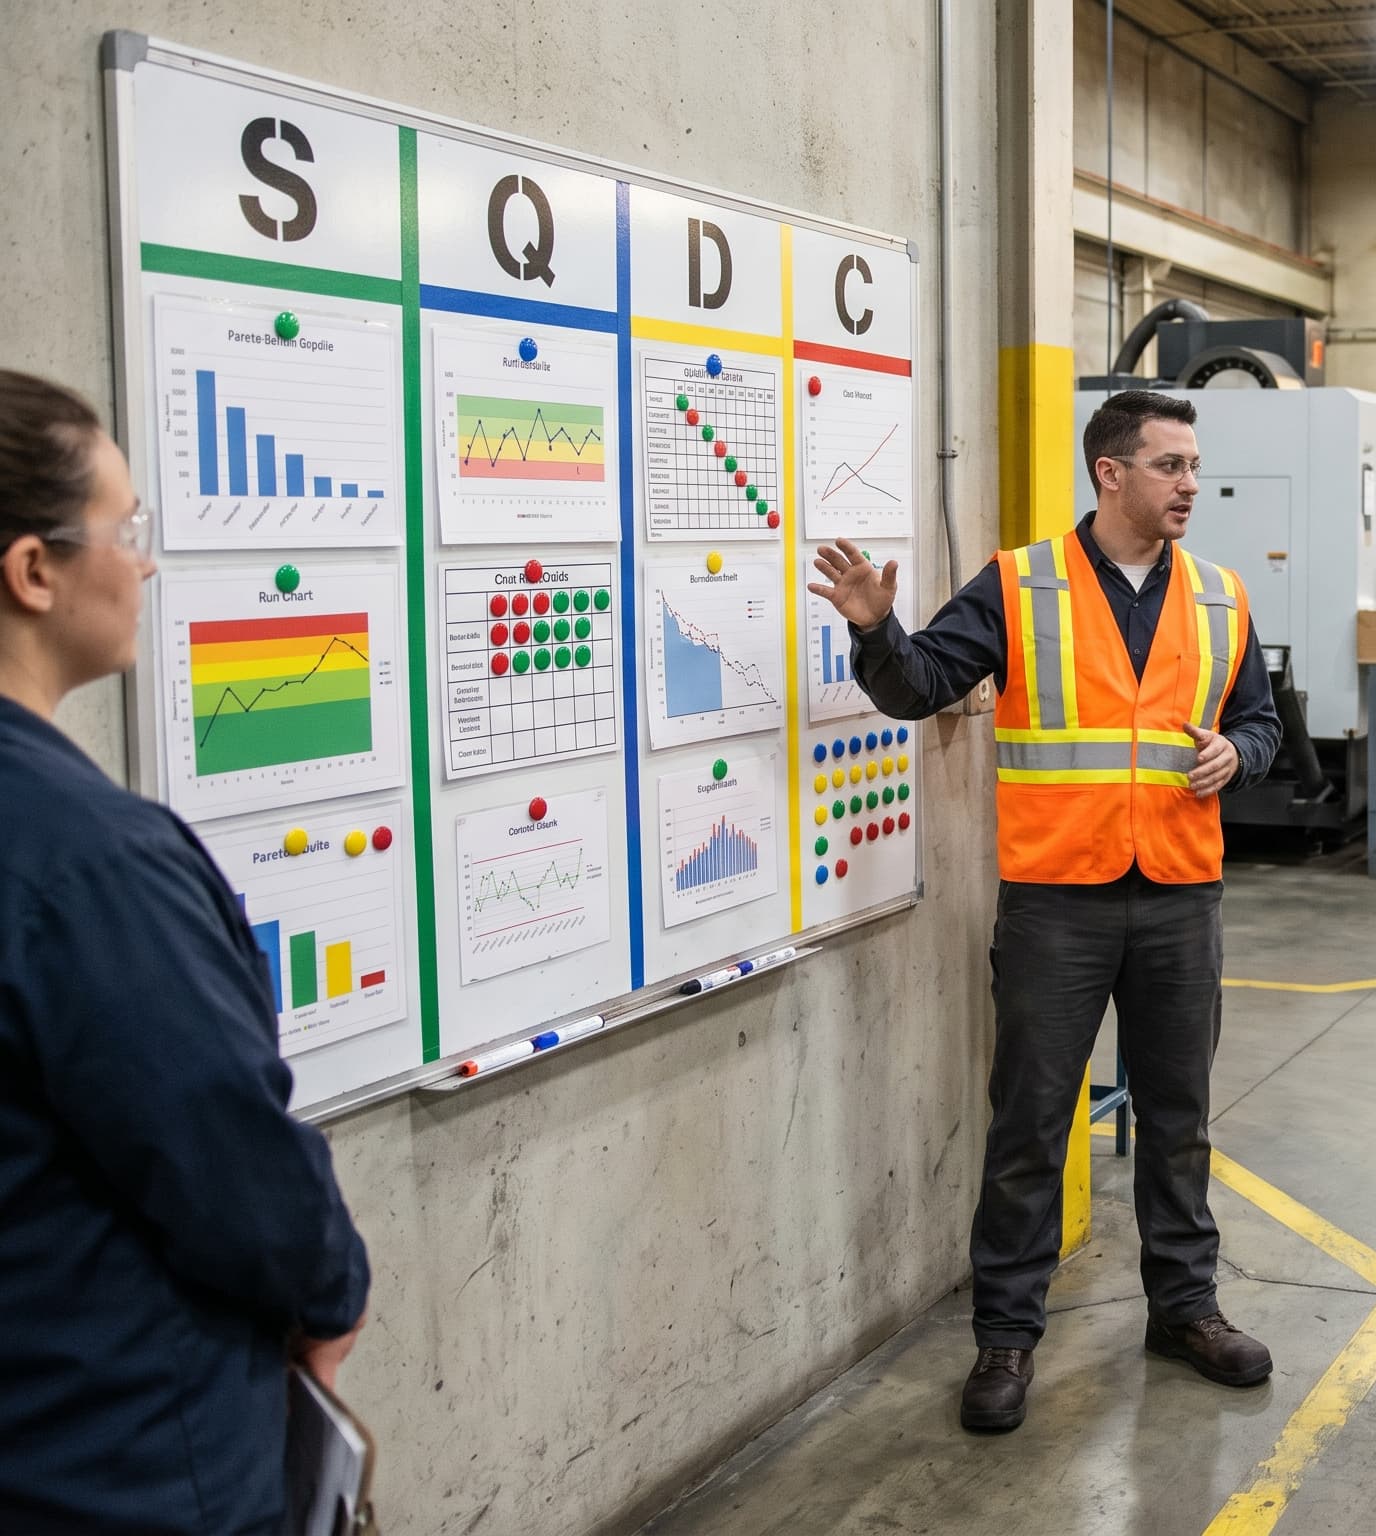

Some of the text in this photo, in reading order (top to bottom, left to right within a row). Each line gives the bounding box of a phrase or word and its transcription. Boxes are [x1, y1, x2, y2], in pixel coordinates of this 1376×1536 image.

[238, 117, 318, 243] S
[487, 174, 556, 289] Q
[688, 217, 733, 310] D
[835, 254, 874, 336] C
[259, 589, 314, 603] Run Chart
